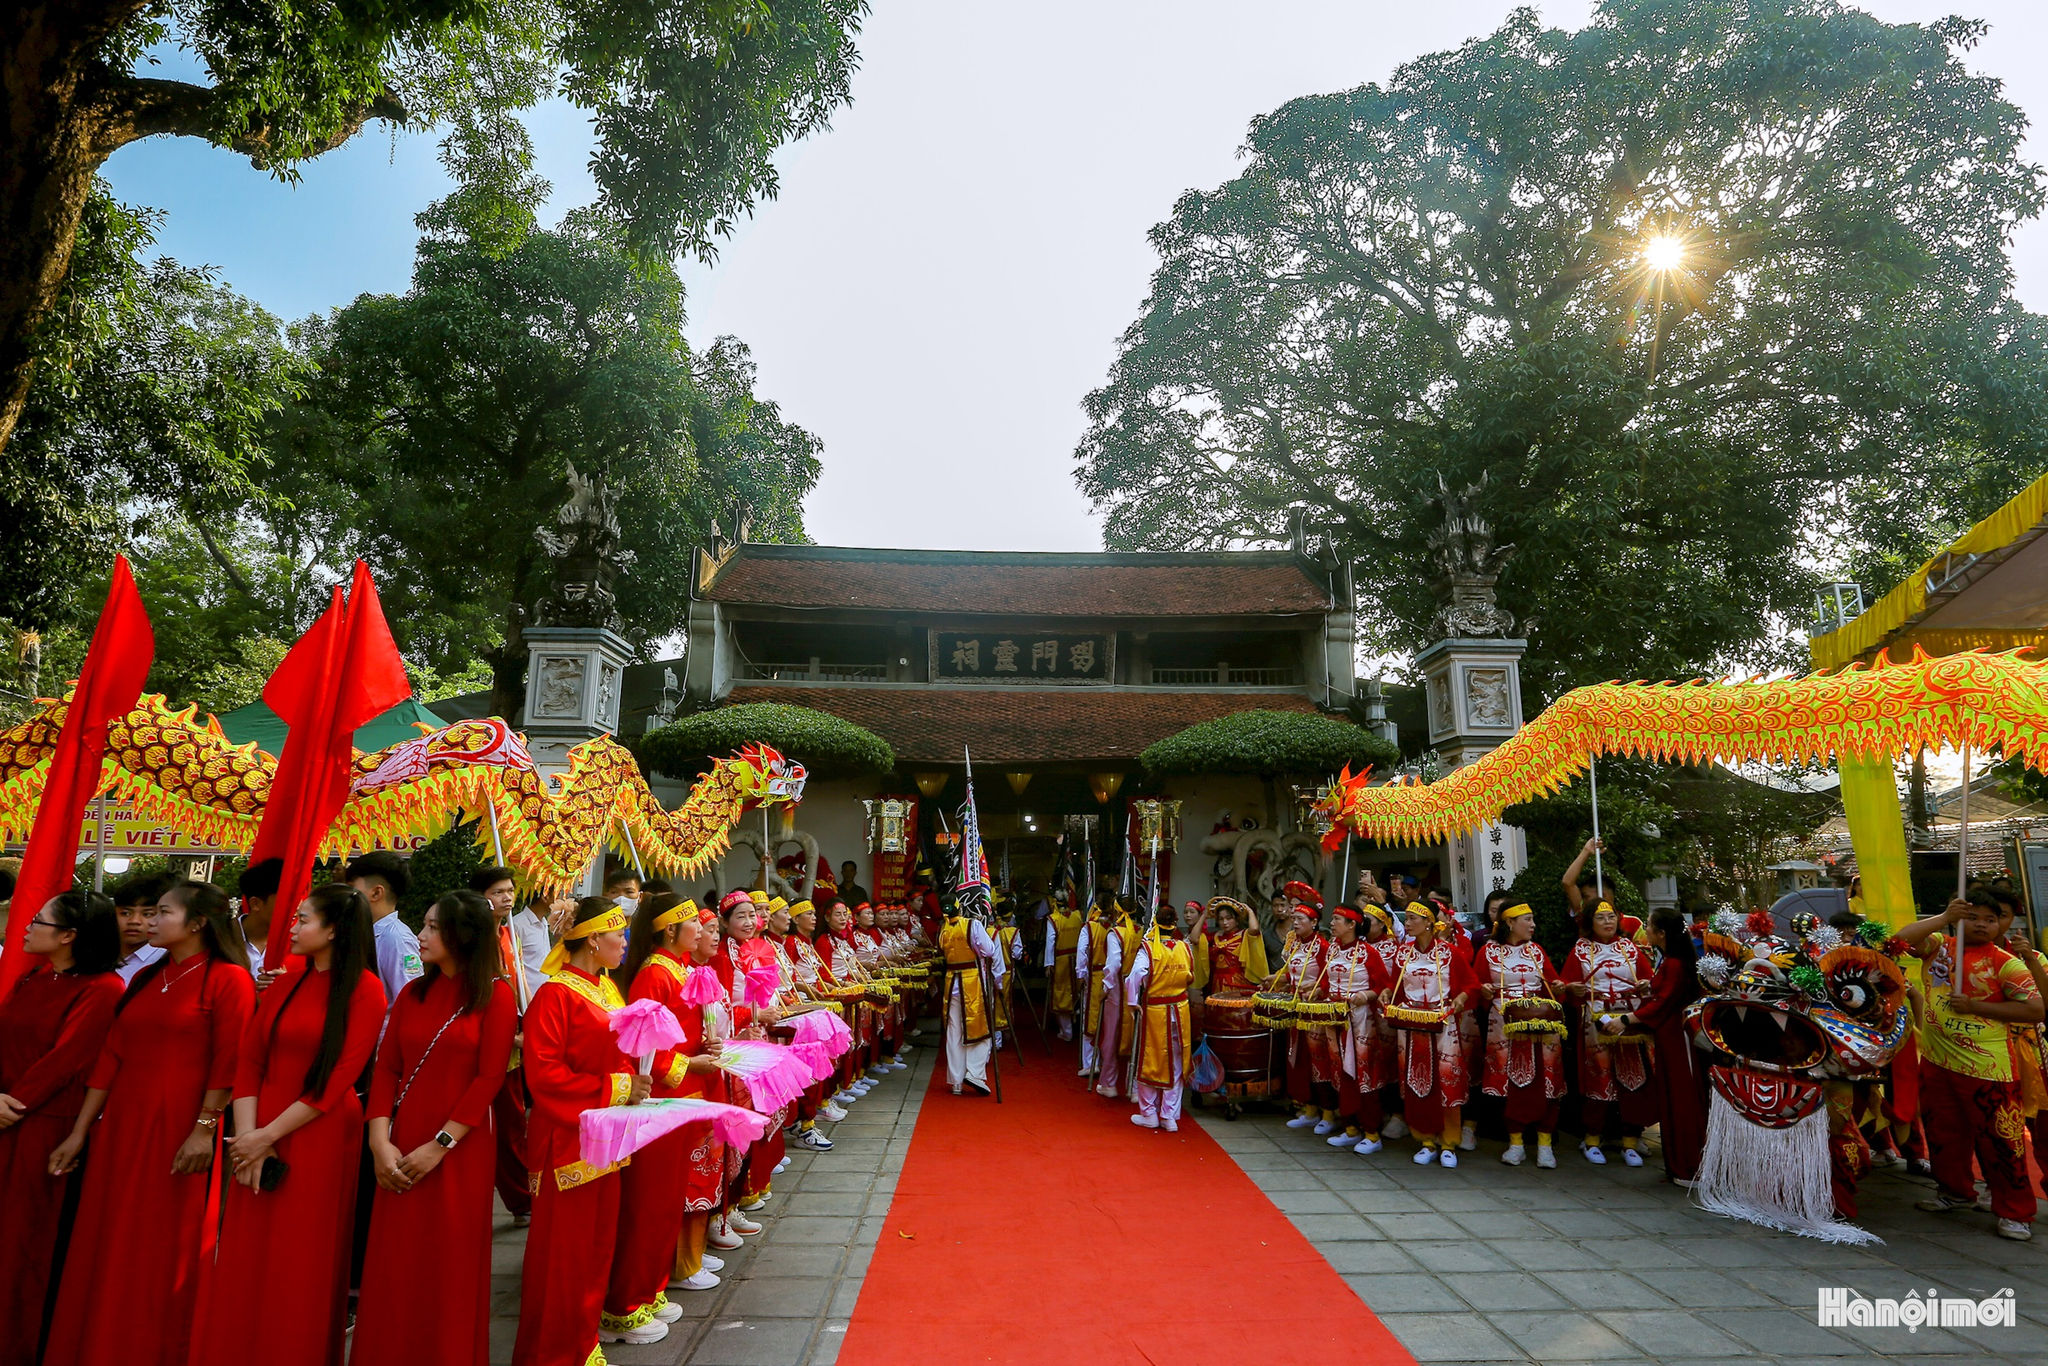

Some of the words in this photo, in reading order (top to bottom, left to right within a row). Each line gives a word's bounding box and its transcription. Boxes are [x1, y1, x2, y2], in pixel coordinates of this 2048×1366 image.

[84, 823, 114, 845] LỄ
[126, 826, 182, 847] VIẾT
[676, 903, 694, 919] ĐỀN
[606, 912, 625, 929] ĐỀN
